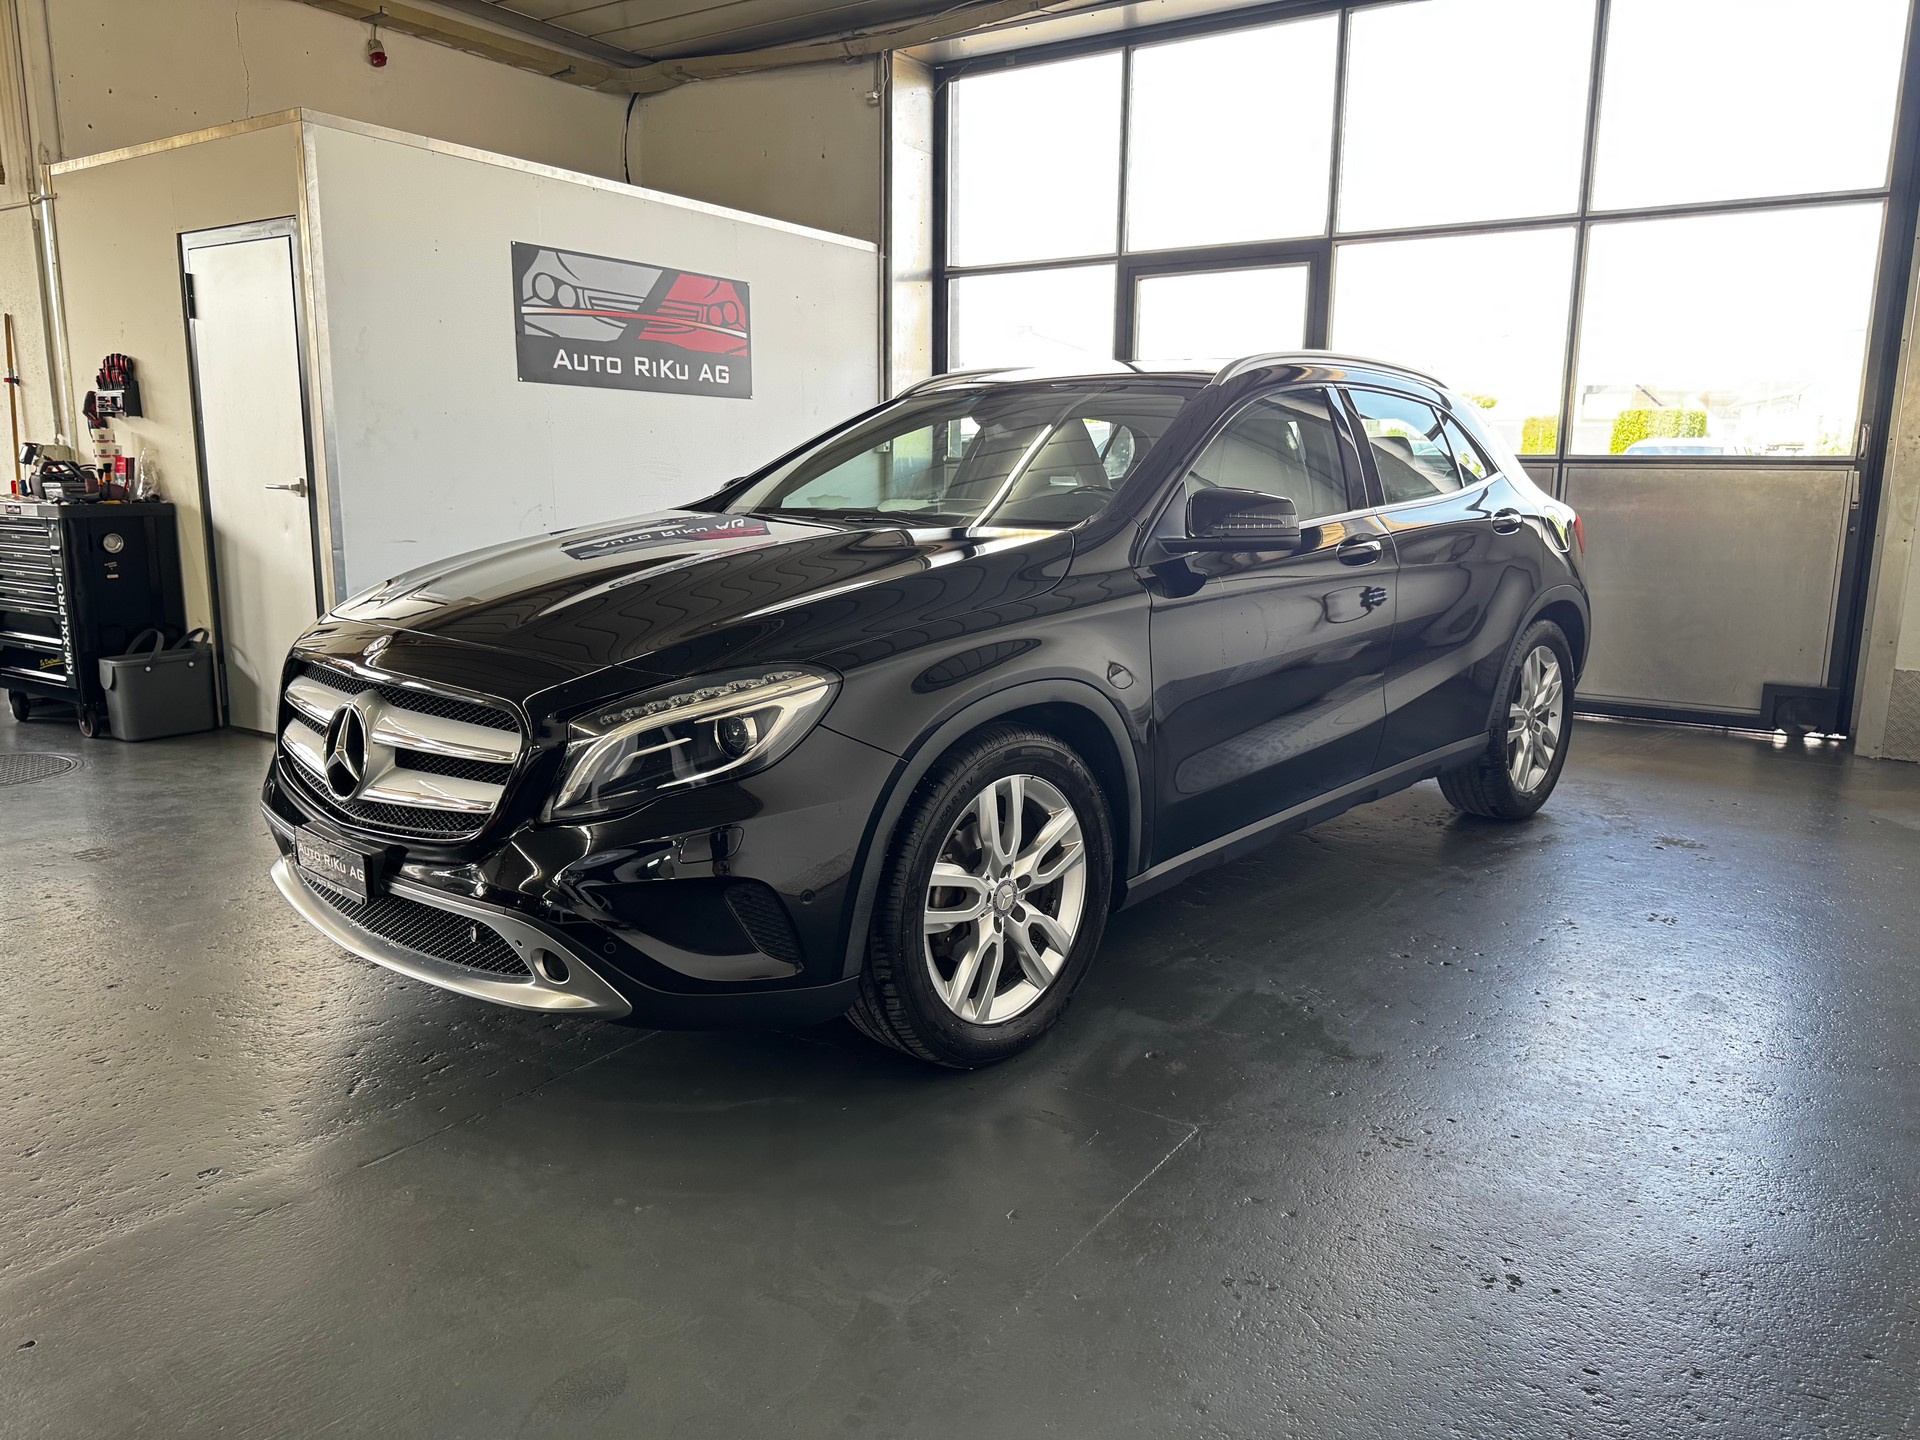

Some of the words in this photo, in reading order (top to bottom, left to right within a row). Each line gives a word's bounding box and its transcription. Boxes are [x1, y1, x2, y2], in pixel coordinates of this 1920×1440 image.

[553, 349, 622, 375] AUTO
[698, 364, 730, 384] AG
[298, 842, 321, 861] AUTO
[349, 866, 365, 882] AG
